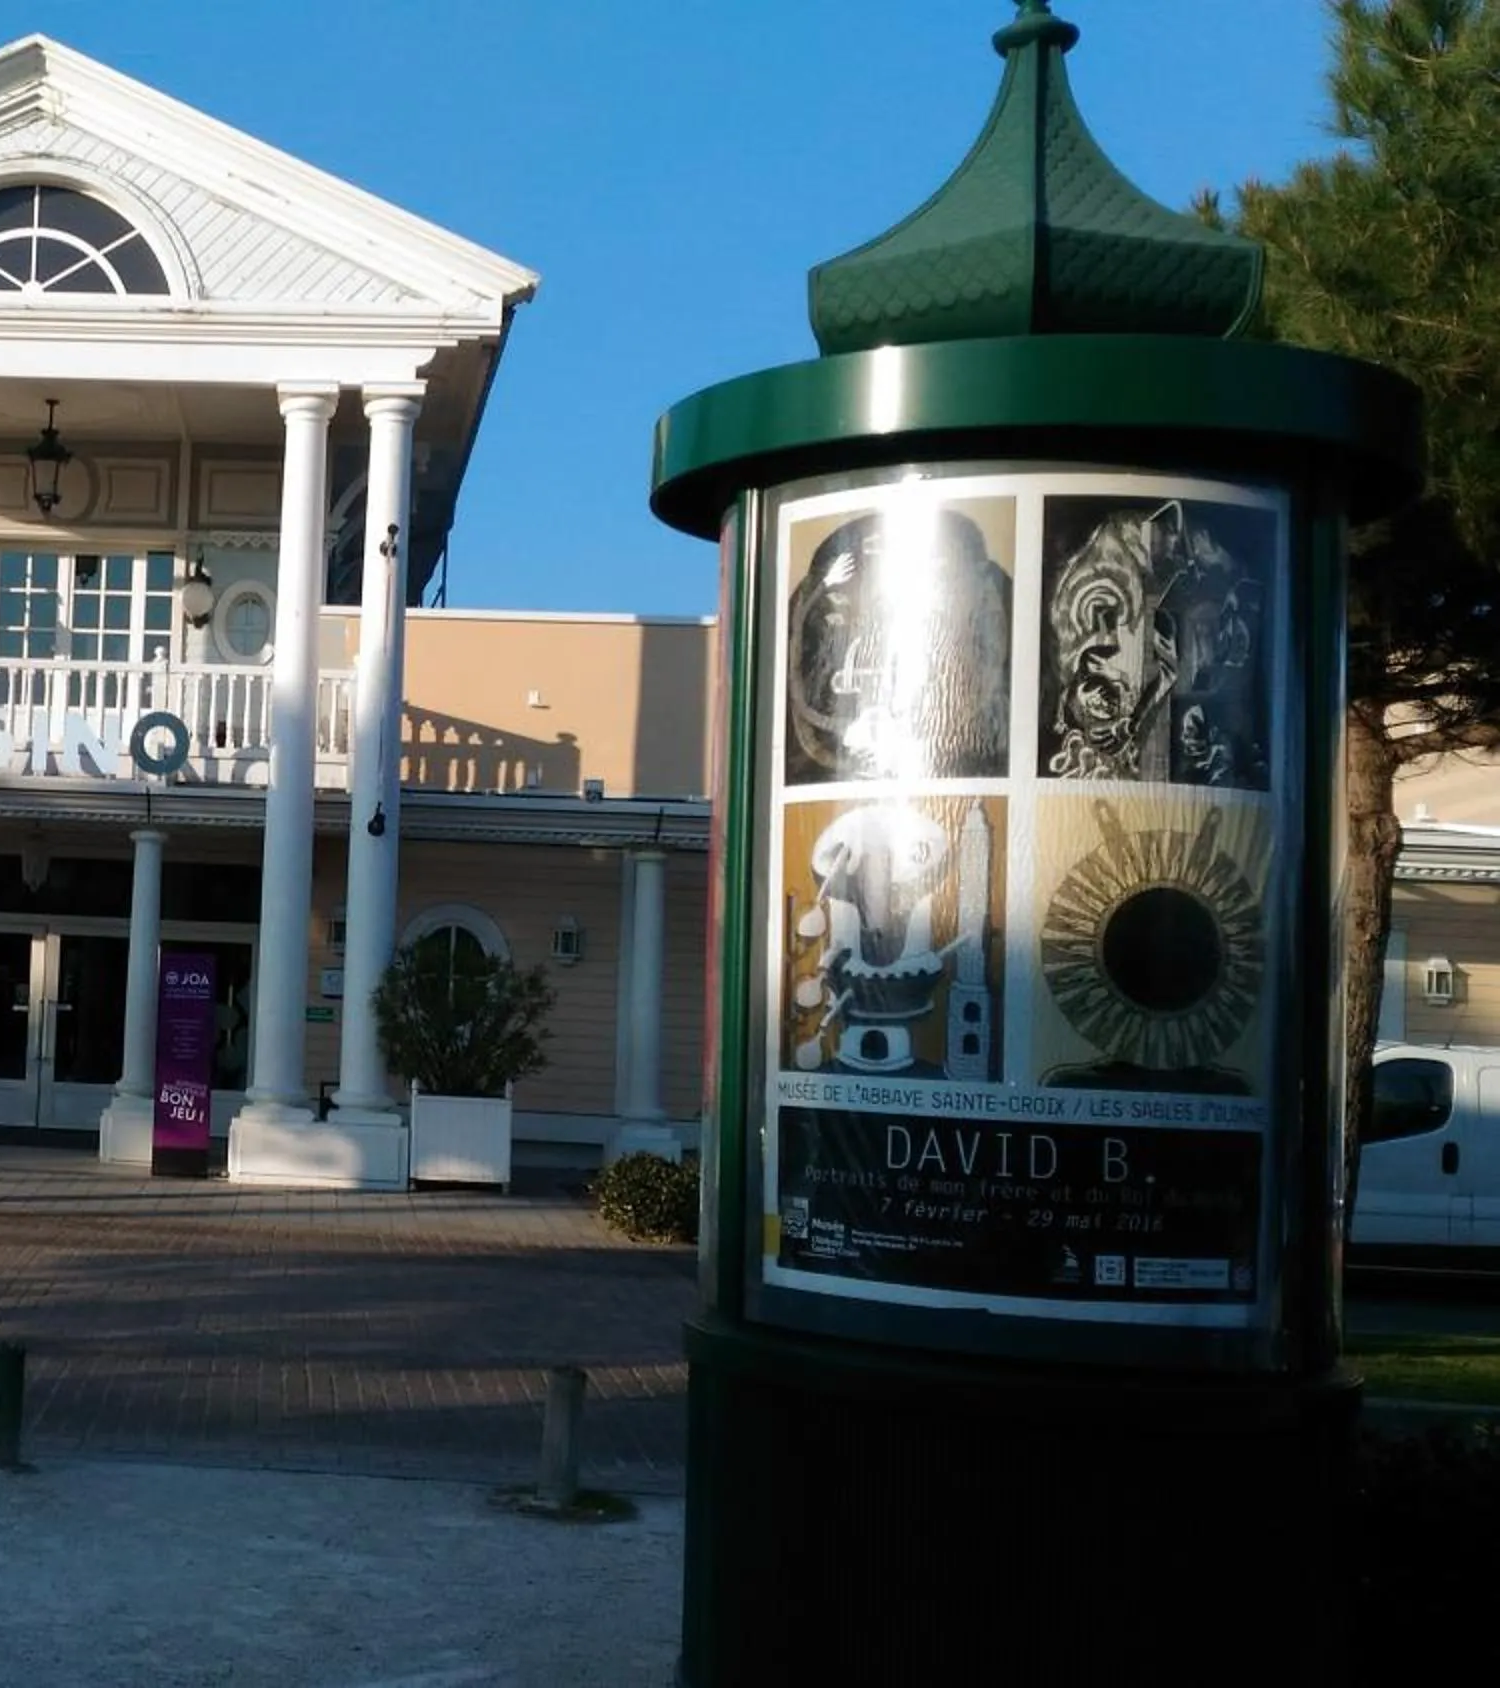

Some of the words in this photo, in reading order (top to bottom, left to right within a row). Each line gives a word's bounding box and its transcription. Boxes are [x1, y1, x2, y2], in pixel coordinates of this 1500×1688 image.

[181, 973, 210, 985] JOA
[160, 1090, 194, 1108] BON
[169, 1105, 196, 1121] JEU
[778, 1078, 818, 1101] MUSÉE
[823, 1084, 841, 1102] DE
[847, 1084, 924, 1108] L'ABBAYE
[931, 1091, 1065, 1115] SAINTE-CROIX
[1090, 1099, 1123, 1118] LES
[1131, 1101, 1194, 1121] SABLES
[886, 1125, 1057, 1180] DAVID
[1103, 1137, 1156, 1184] B.
[805, 1164, 887, 1190] Portraits
[897, 1174, 922, 1194] de
[930, 1179, 966, 1196] mon
[881, 1196, 892, 1215] 7
[904, 1199, 989, 1223] février
[1026, 1209, 1054, 1228] 29
[1065, 1211, 1102, 1230] mai
